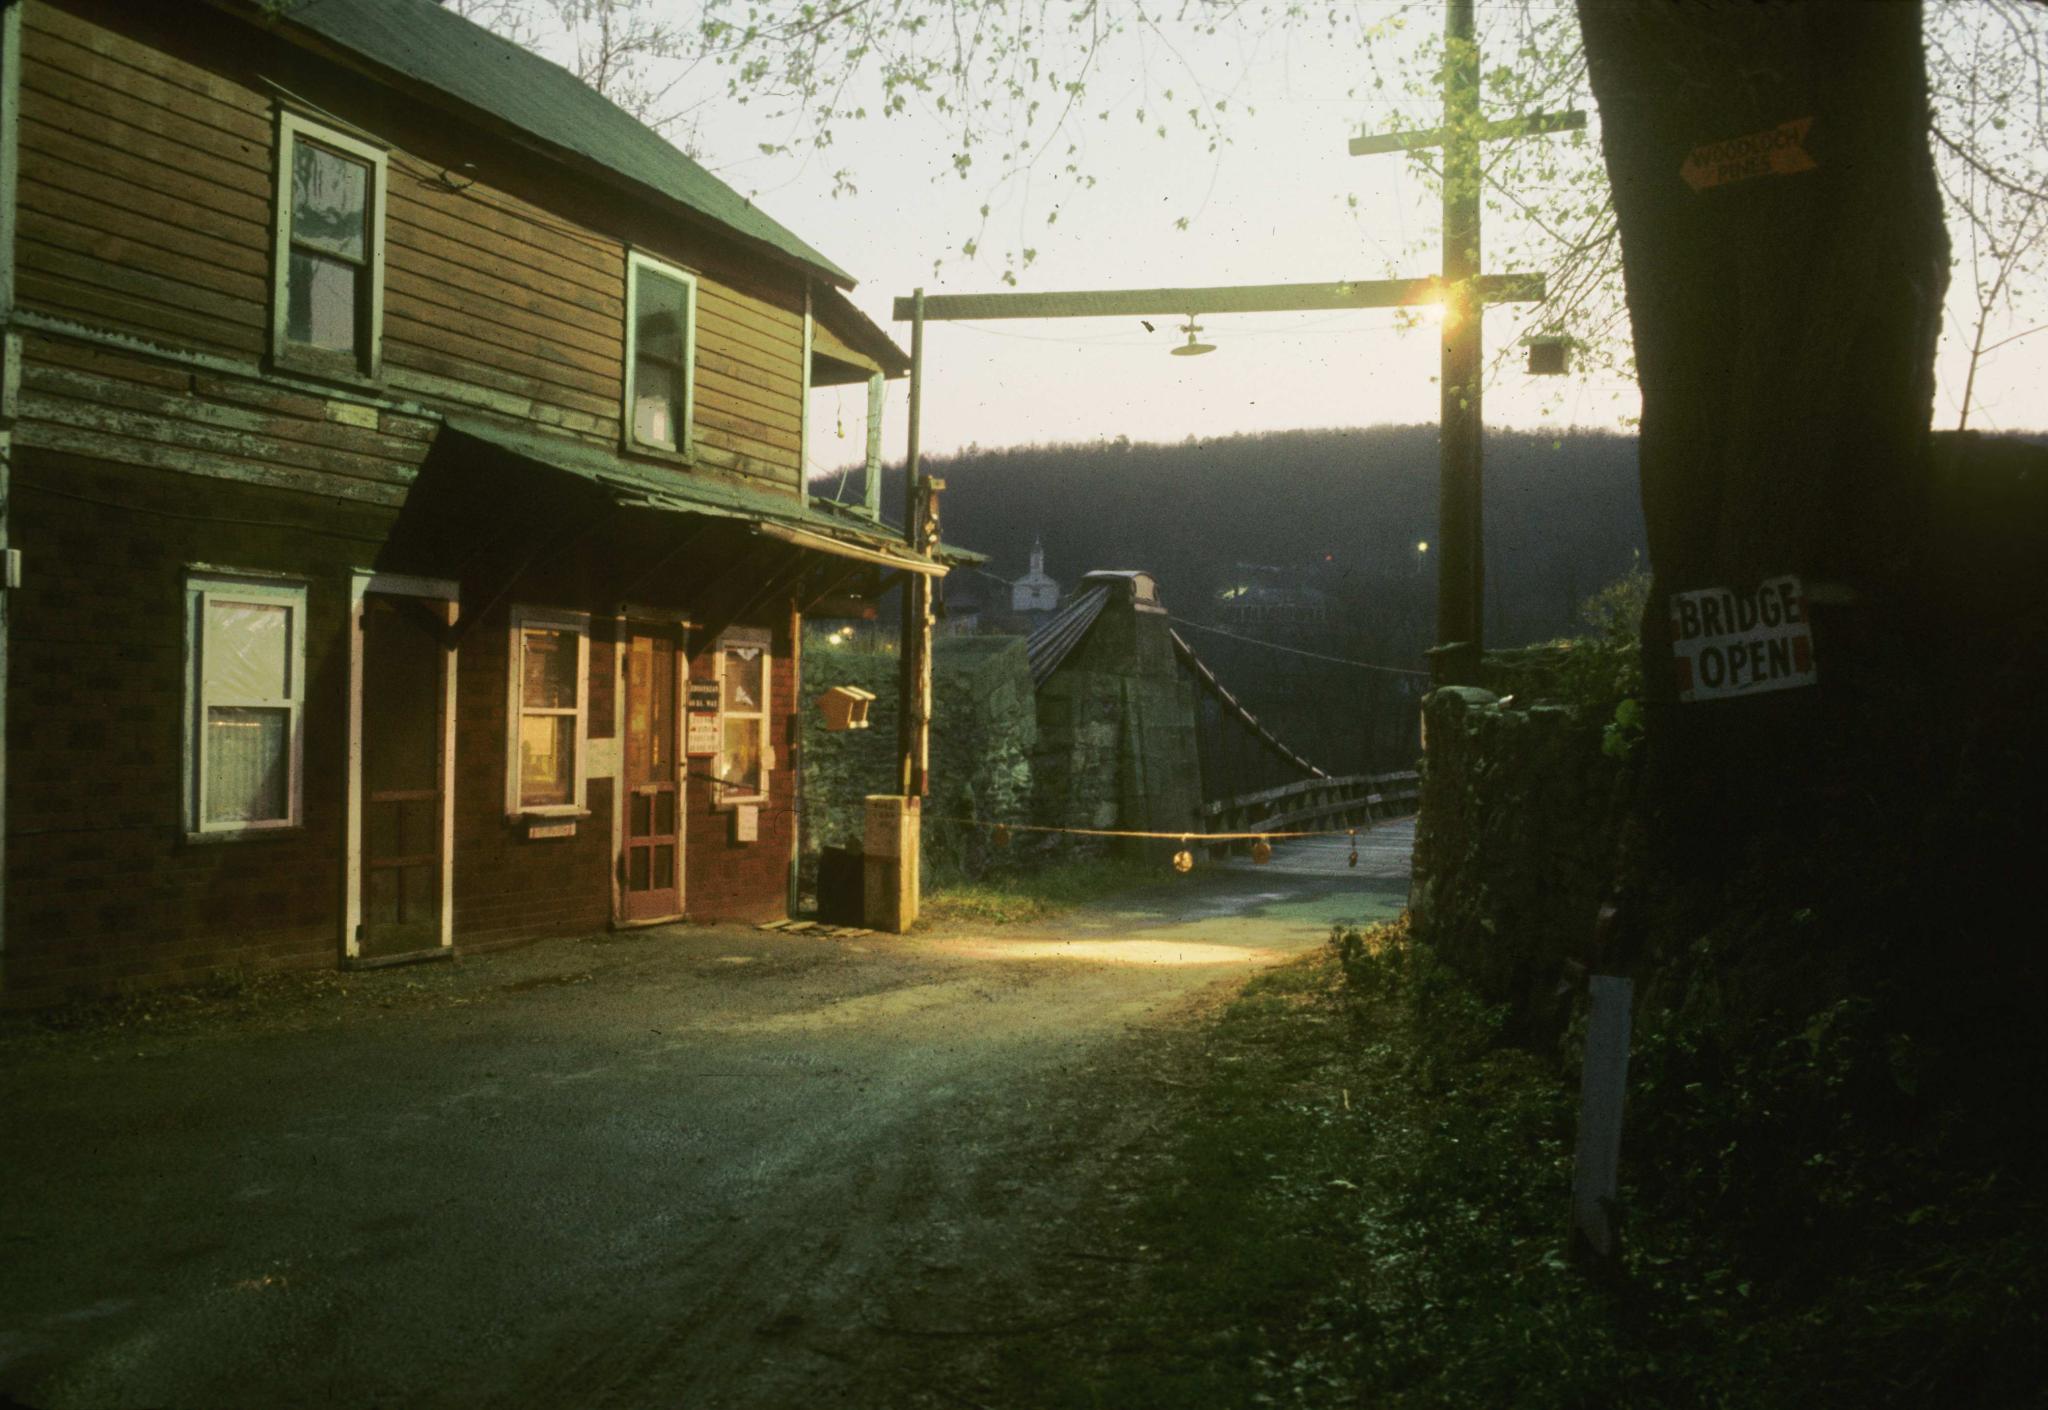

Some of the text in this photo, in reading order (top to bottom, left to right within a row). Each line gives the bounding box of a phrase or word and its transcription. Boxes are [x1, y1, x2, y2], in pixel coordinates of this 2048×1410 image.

[1691, 126, 1800, 167] WOODLOCH
[1678, 582, 1801, 640] BRIDGE
[1699, 636, 1791, 689] OPEN
